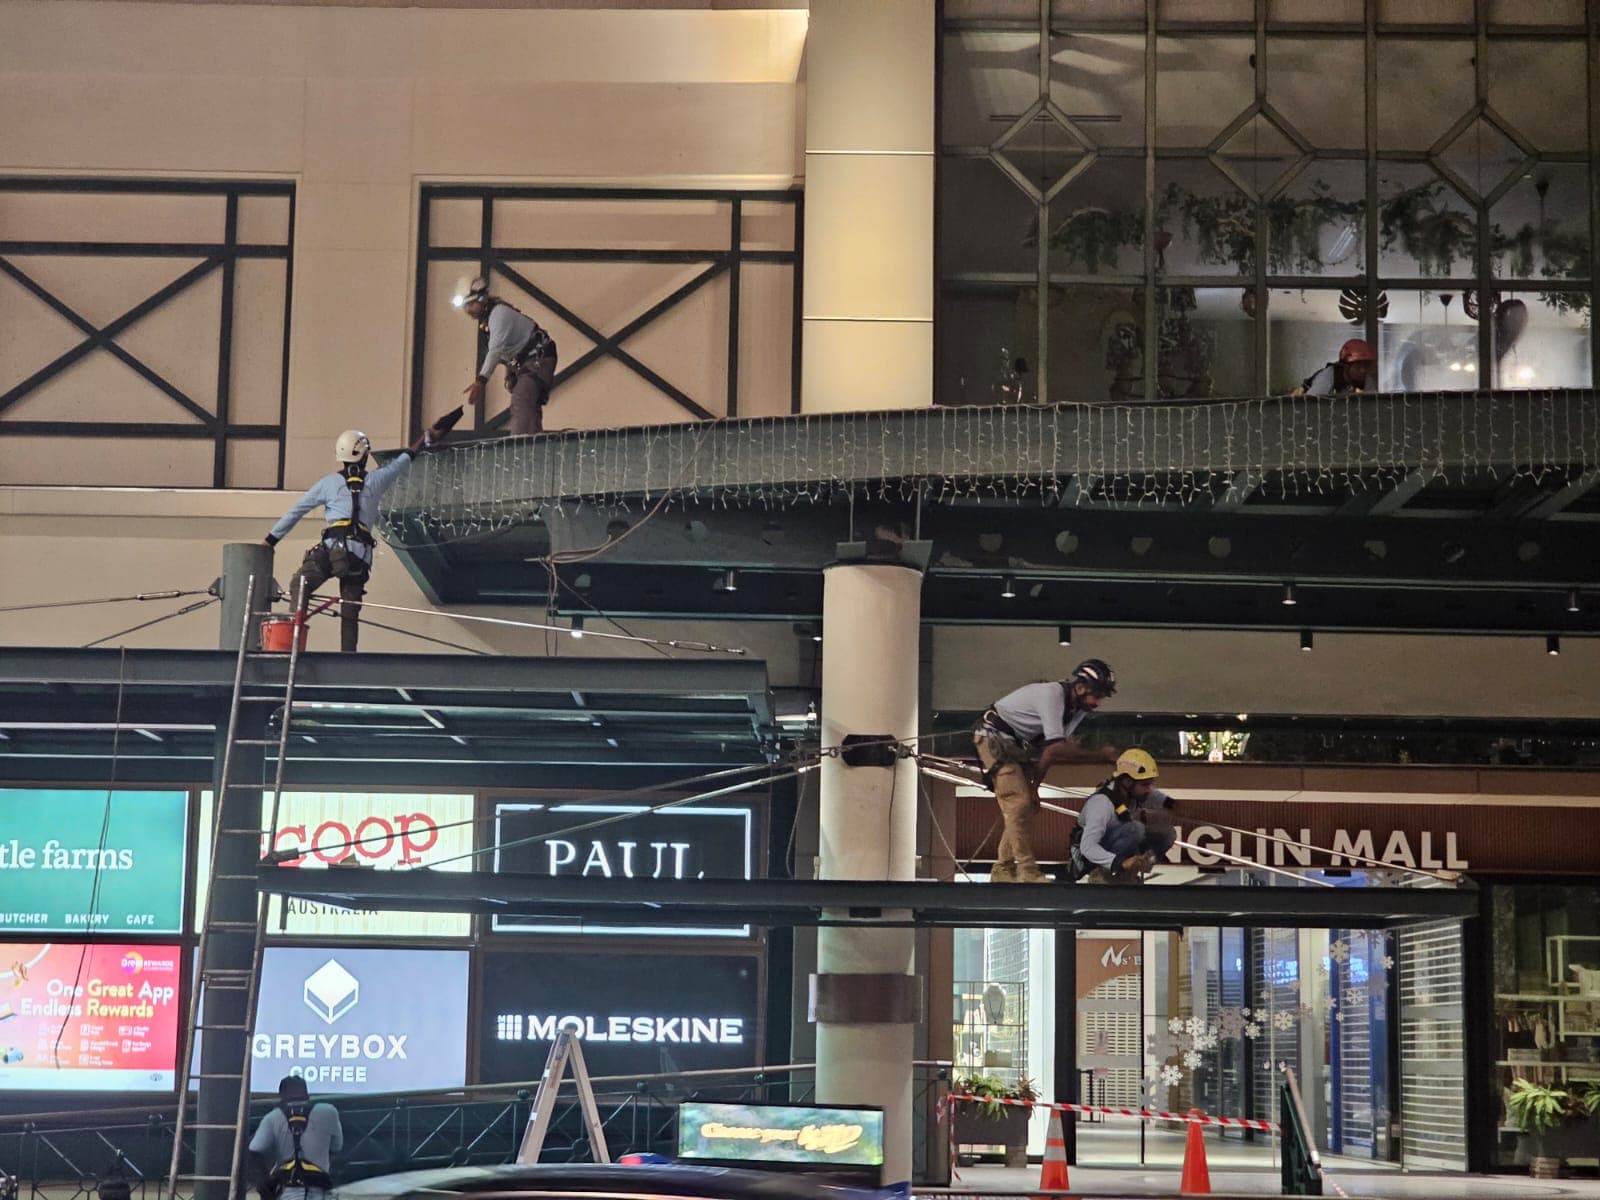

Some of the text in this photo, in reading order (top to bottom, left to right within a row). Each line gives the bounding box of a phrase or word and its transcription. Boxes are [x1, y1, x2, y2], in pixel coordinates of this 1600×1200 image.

[260, 812, 438, 868] coop
[1331, 828, 1469, 869] MALL
[41, 839, 134, 870] farms
[0, 913, 155, 925] BUTCHER BAKERY CAFE
[46, 979, 174, 1006] One Great App
[21, 998, 154, 1018] Endless Rewards
[527, 1015, 743, 1043] MOLESKINE
[252, 1034, 408, 1060] GREYBOX
[289, 1065, 367, 1083] COFFEE
